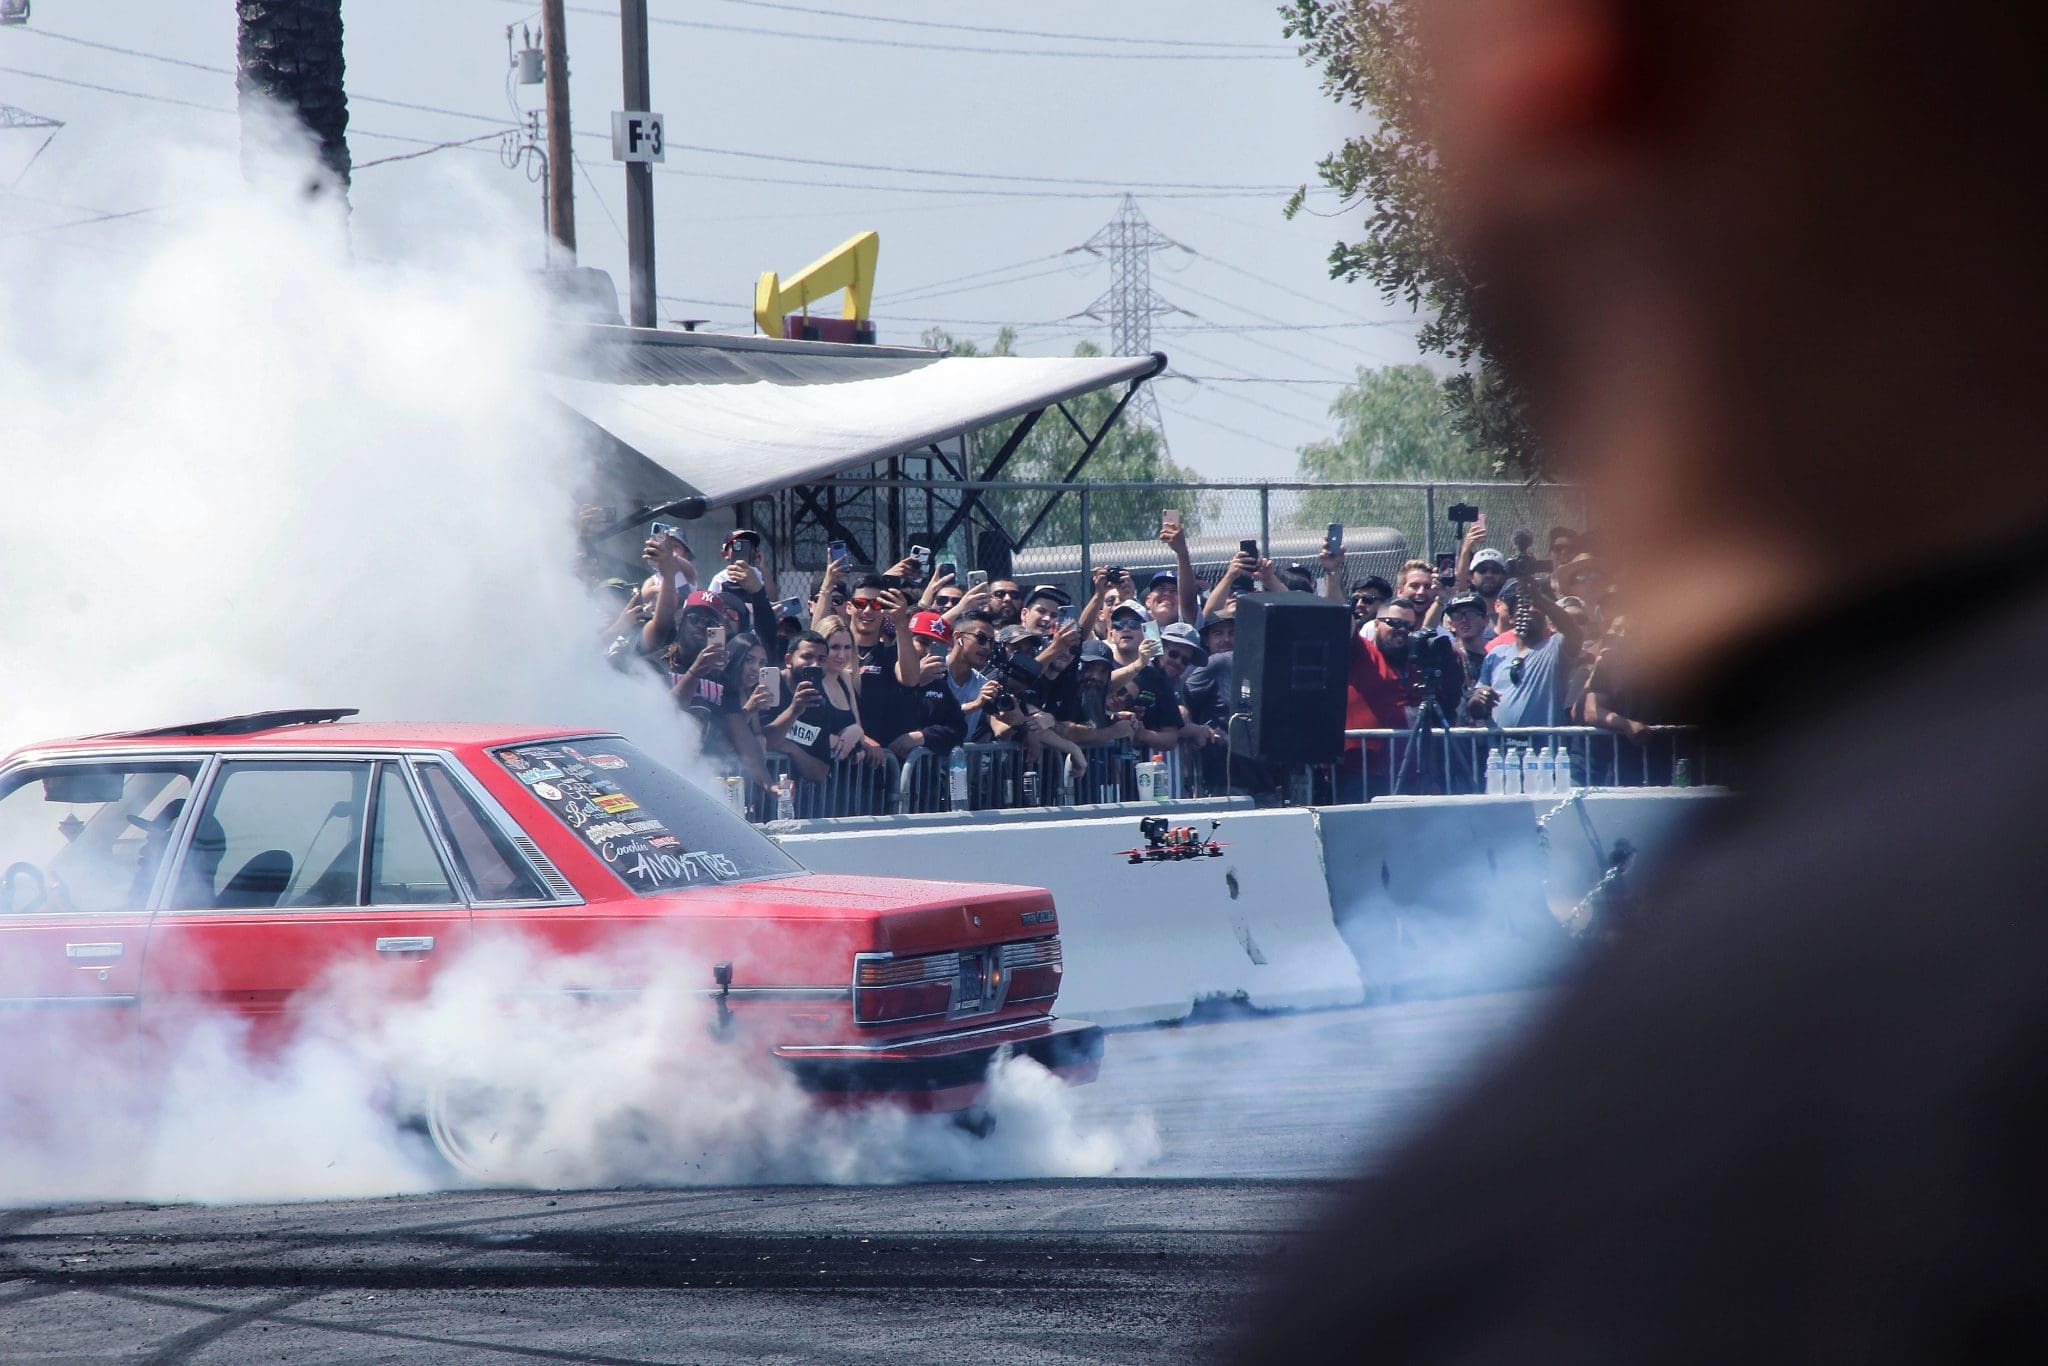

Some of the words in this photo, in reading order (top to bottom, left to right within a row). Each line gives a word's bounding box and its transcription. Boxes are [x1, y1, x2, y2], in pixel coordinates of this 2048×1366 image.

[629, 119, 662, 155] F-3
[701, 591, 714, 603] NY
[602, 838, 649, 863] Cooolin
